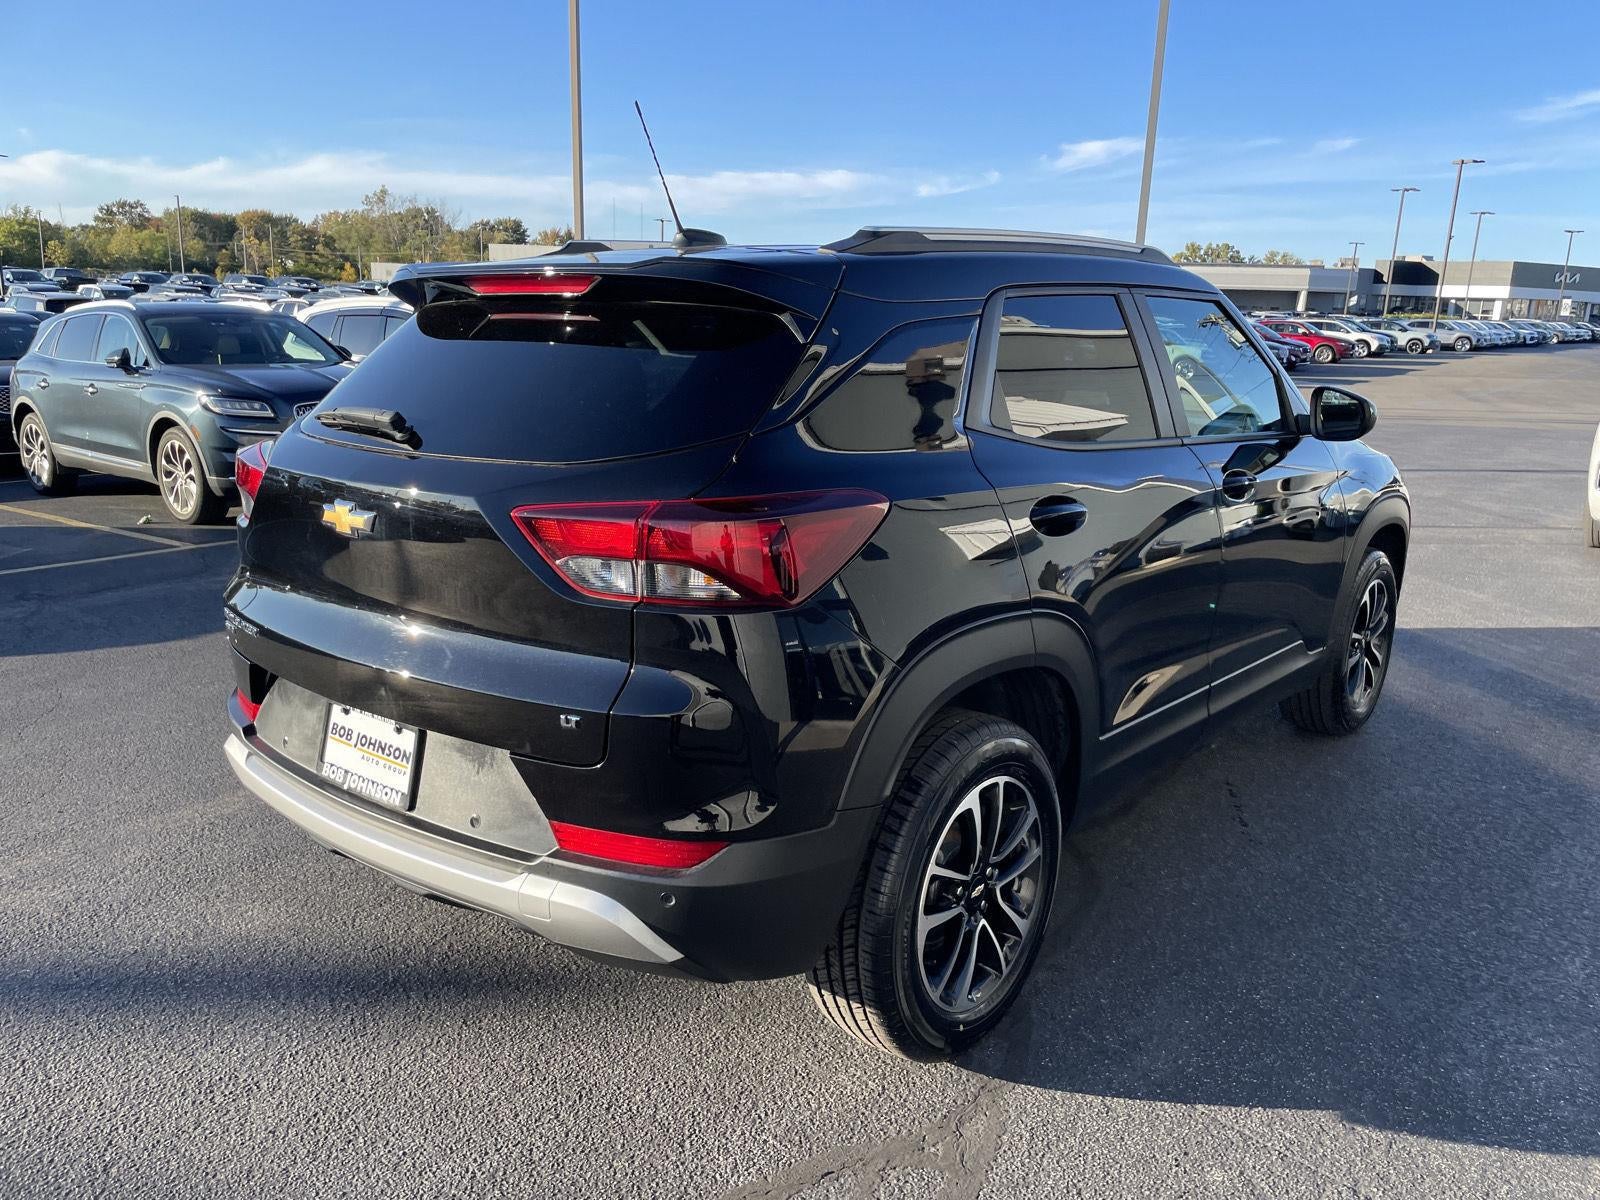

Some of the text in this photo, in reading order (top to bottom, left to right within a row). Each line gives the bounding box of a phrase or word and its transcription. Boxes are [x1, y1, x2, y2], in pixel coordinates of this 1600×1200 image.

[330, 722, 412, 765] BOB JOHNSON
[321, 762, 401, 806] BOB JOHNSON
[361, 754, 408, 777] AUTO GROUP
